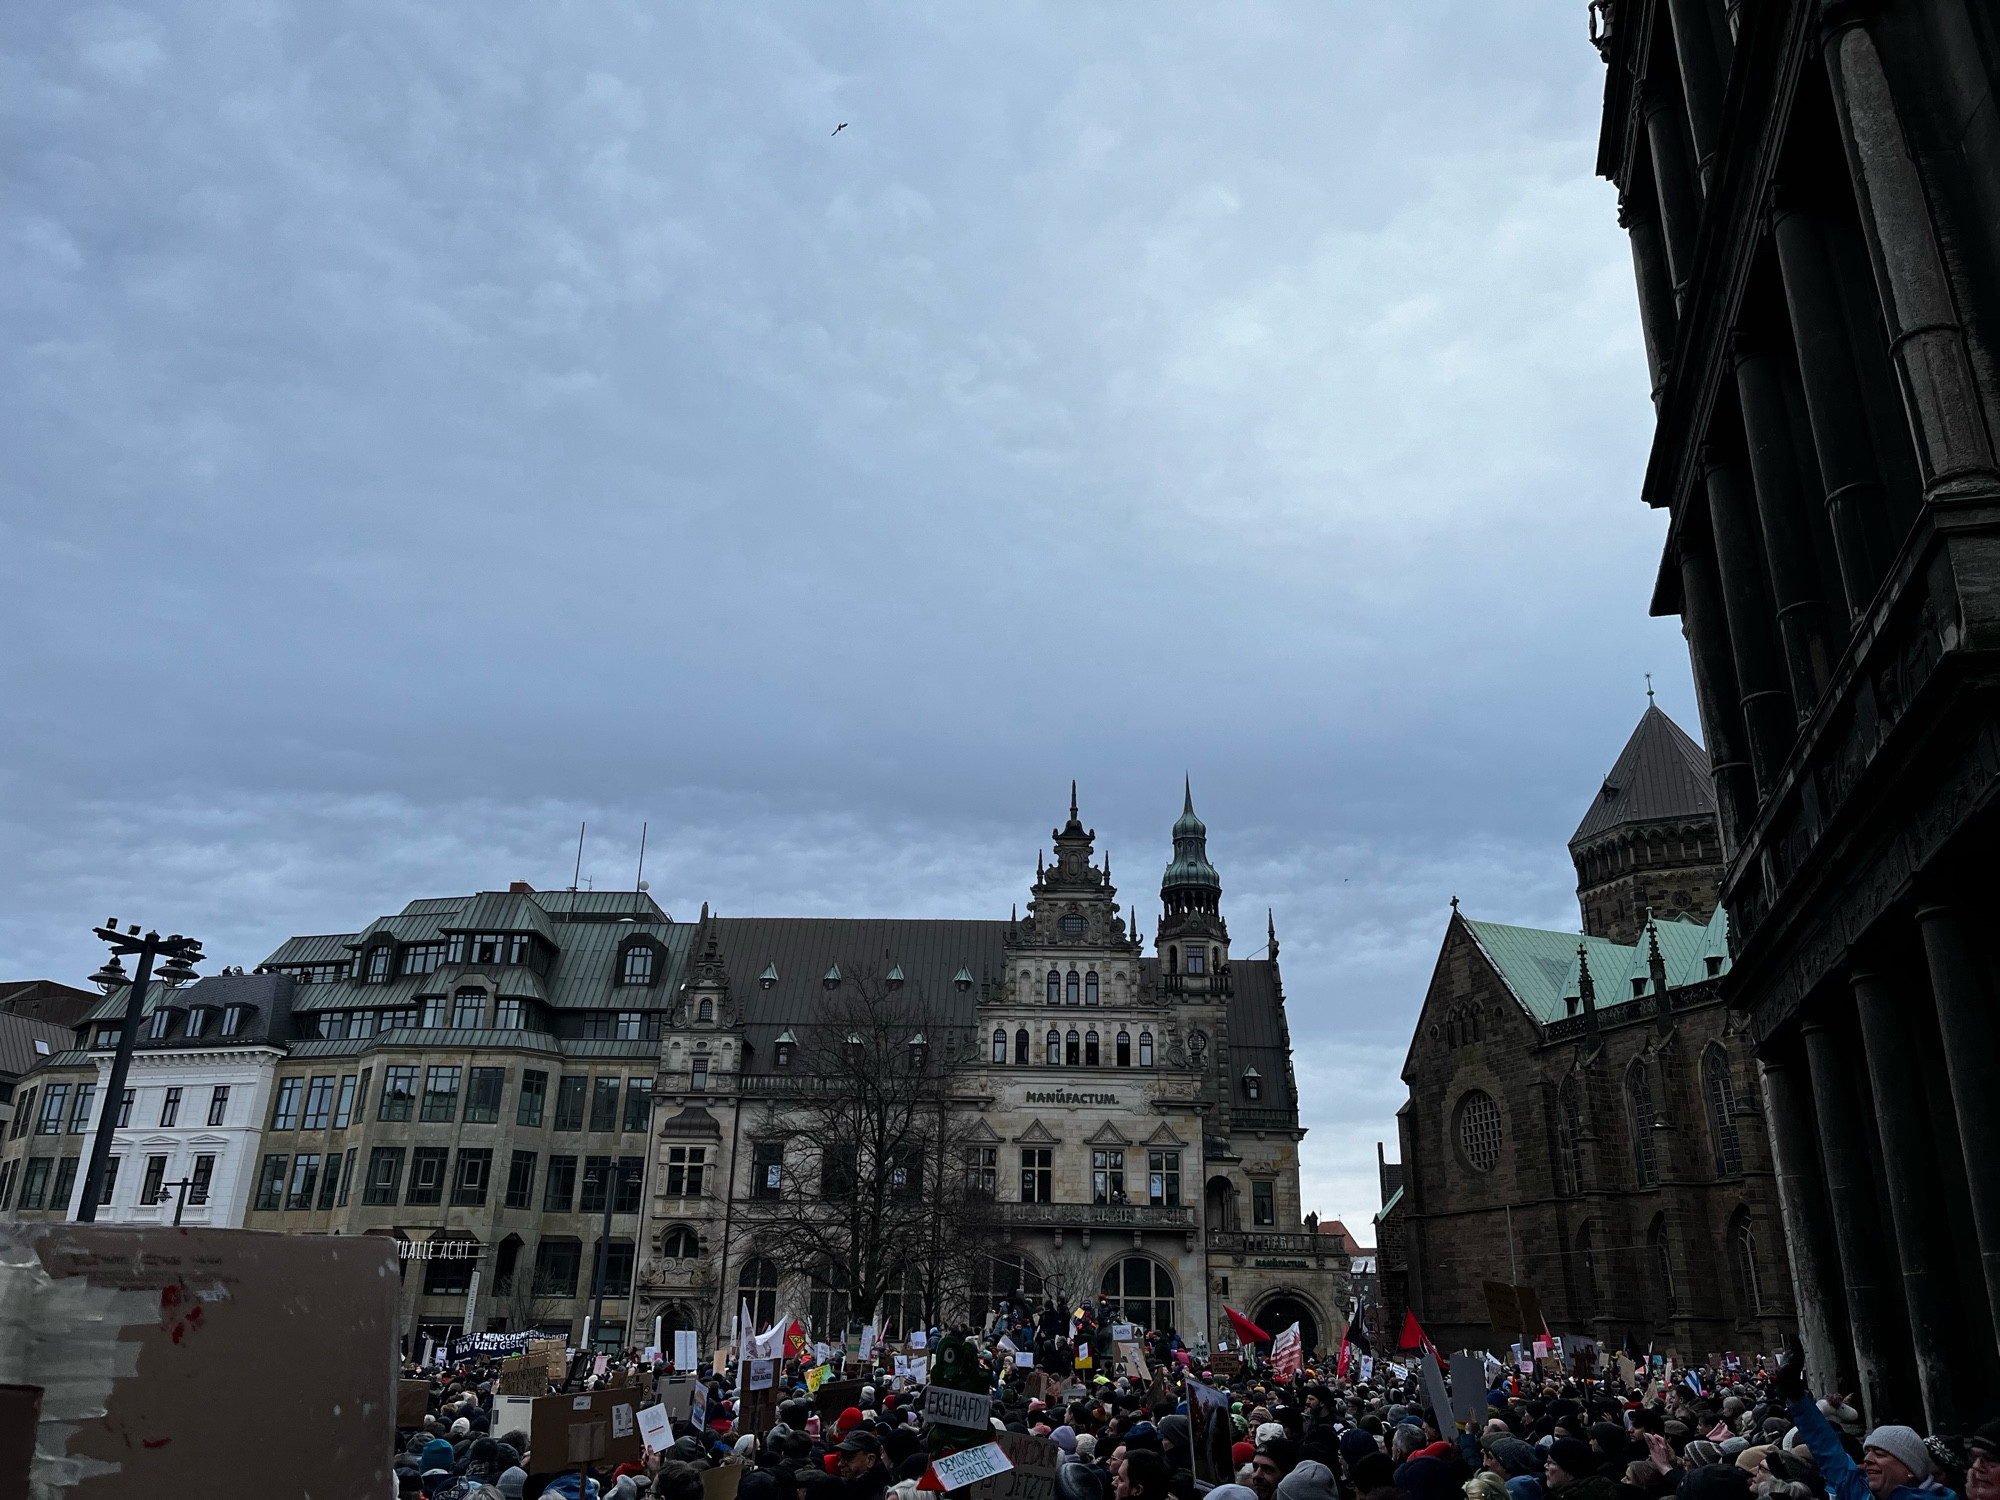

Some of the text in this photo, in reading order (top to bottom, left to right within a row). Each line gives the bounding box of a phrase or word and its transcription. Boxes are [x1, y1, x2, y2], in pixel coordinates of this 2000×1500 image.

[440, 1241, 470, 1260] ACHT
[456, 1341, 473, 1354] HAT
[474, 1341, 498, 1351] VIELE
[939, 1446, 992, 1474] DEMOKRATIE
[952, 1460, 996, 1485] ERHALTEN
